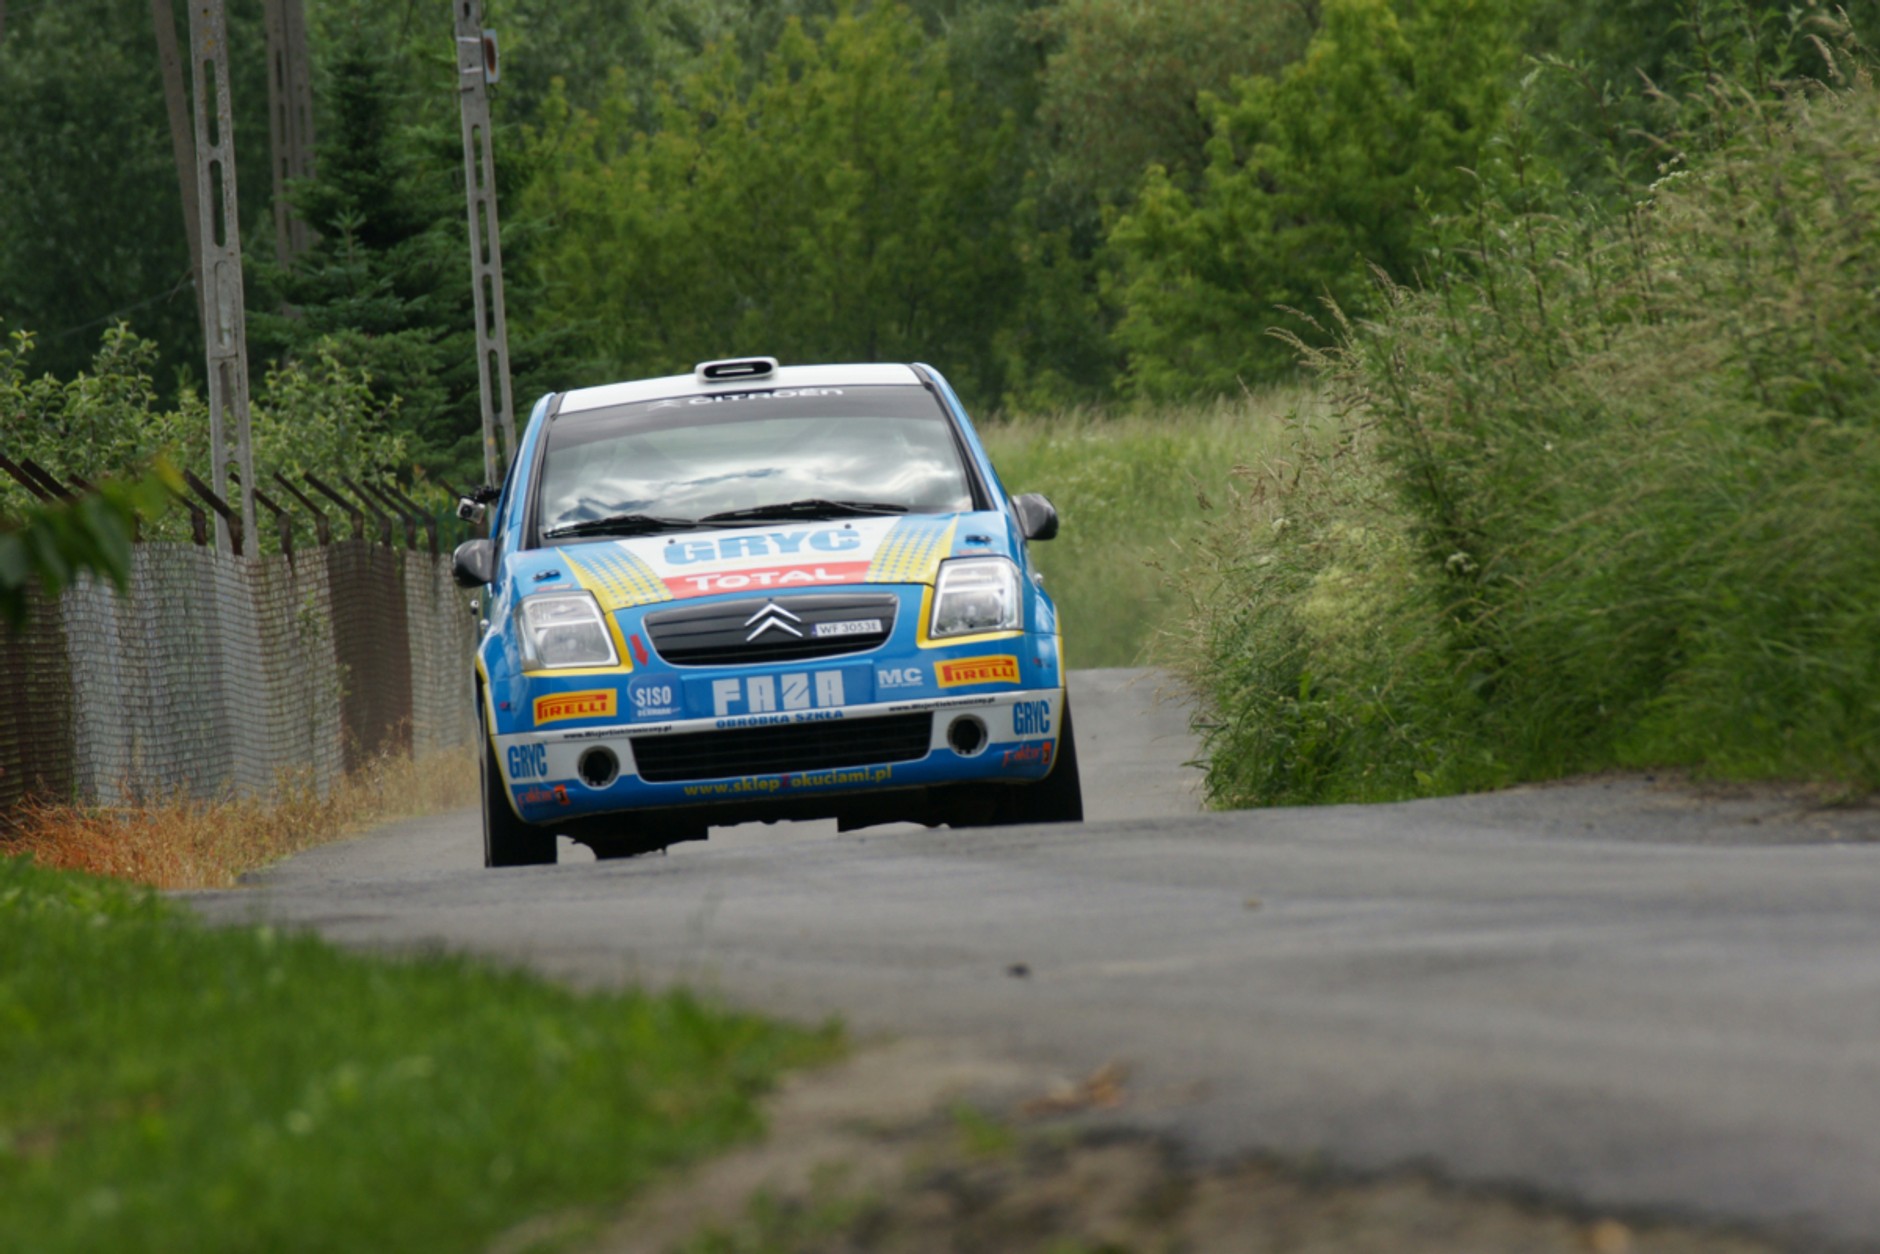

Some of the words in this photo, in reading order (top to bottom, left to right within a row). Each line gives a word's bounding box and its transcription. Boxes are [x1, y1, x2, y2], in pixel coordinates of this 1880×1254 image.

[663, 529, 861, 565] GRYC
[685, 568, 845, 591] TOTAL
[819, 624, 838, 634] WF
[877, 668, 922, 685] MC
[941, 658, 1015, 683] PIRELLI
[635, 682, 672, 707] SISO
[712, 670, 845, 716] FAZA
[537, 694, 608, 720] PIRELLI
[1012, 699, 1050, 736] GRYC
[715, 714, 791, 729] OBRÓBKA
[507, 742, 548, 779] GRYC
